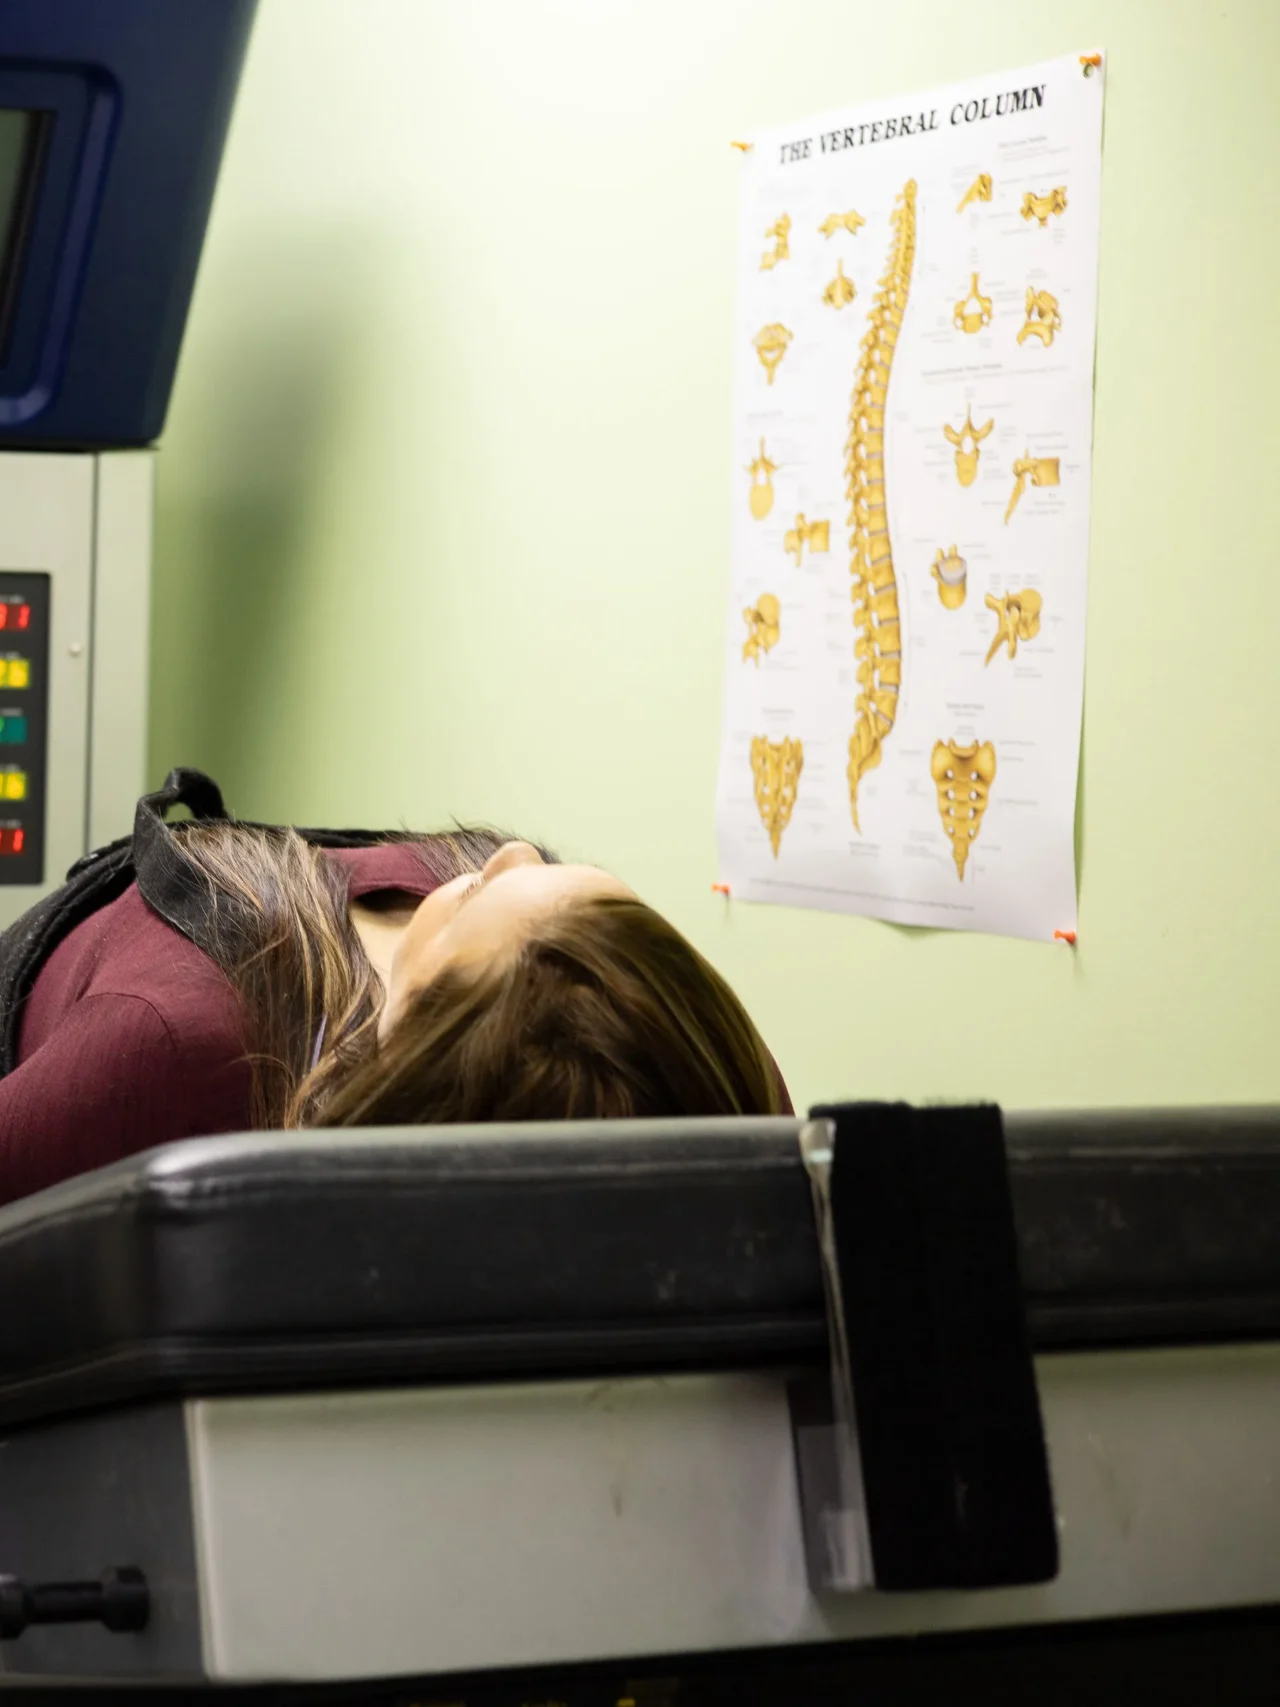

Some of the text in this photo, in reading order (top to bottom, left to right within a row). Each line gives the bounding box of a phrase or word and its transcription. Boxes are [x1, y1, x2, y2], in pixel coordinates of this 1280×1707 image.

[779, 84, 1047, 165] THE VERTEBRAL COLUMN
